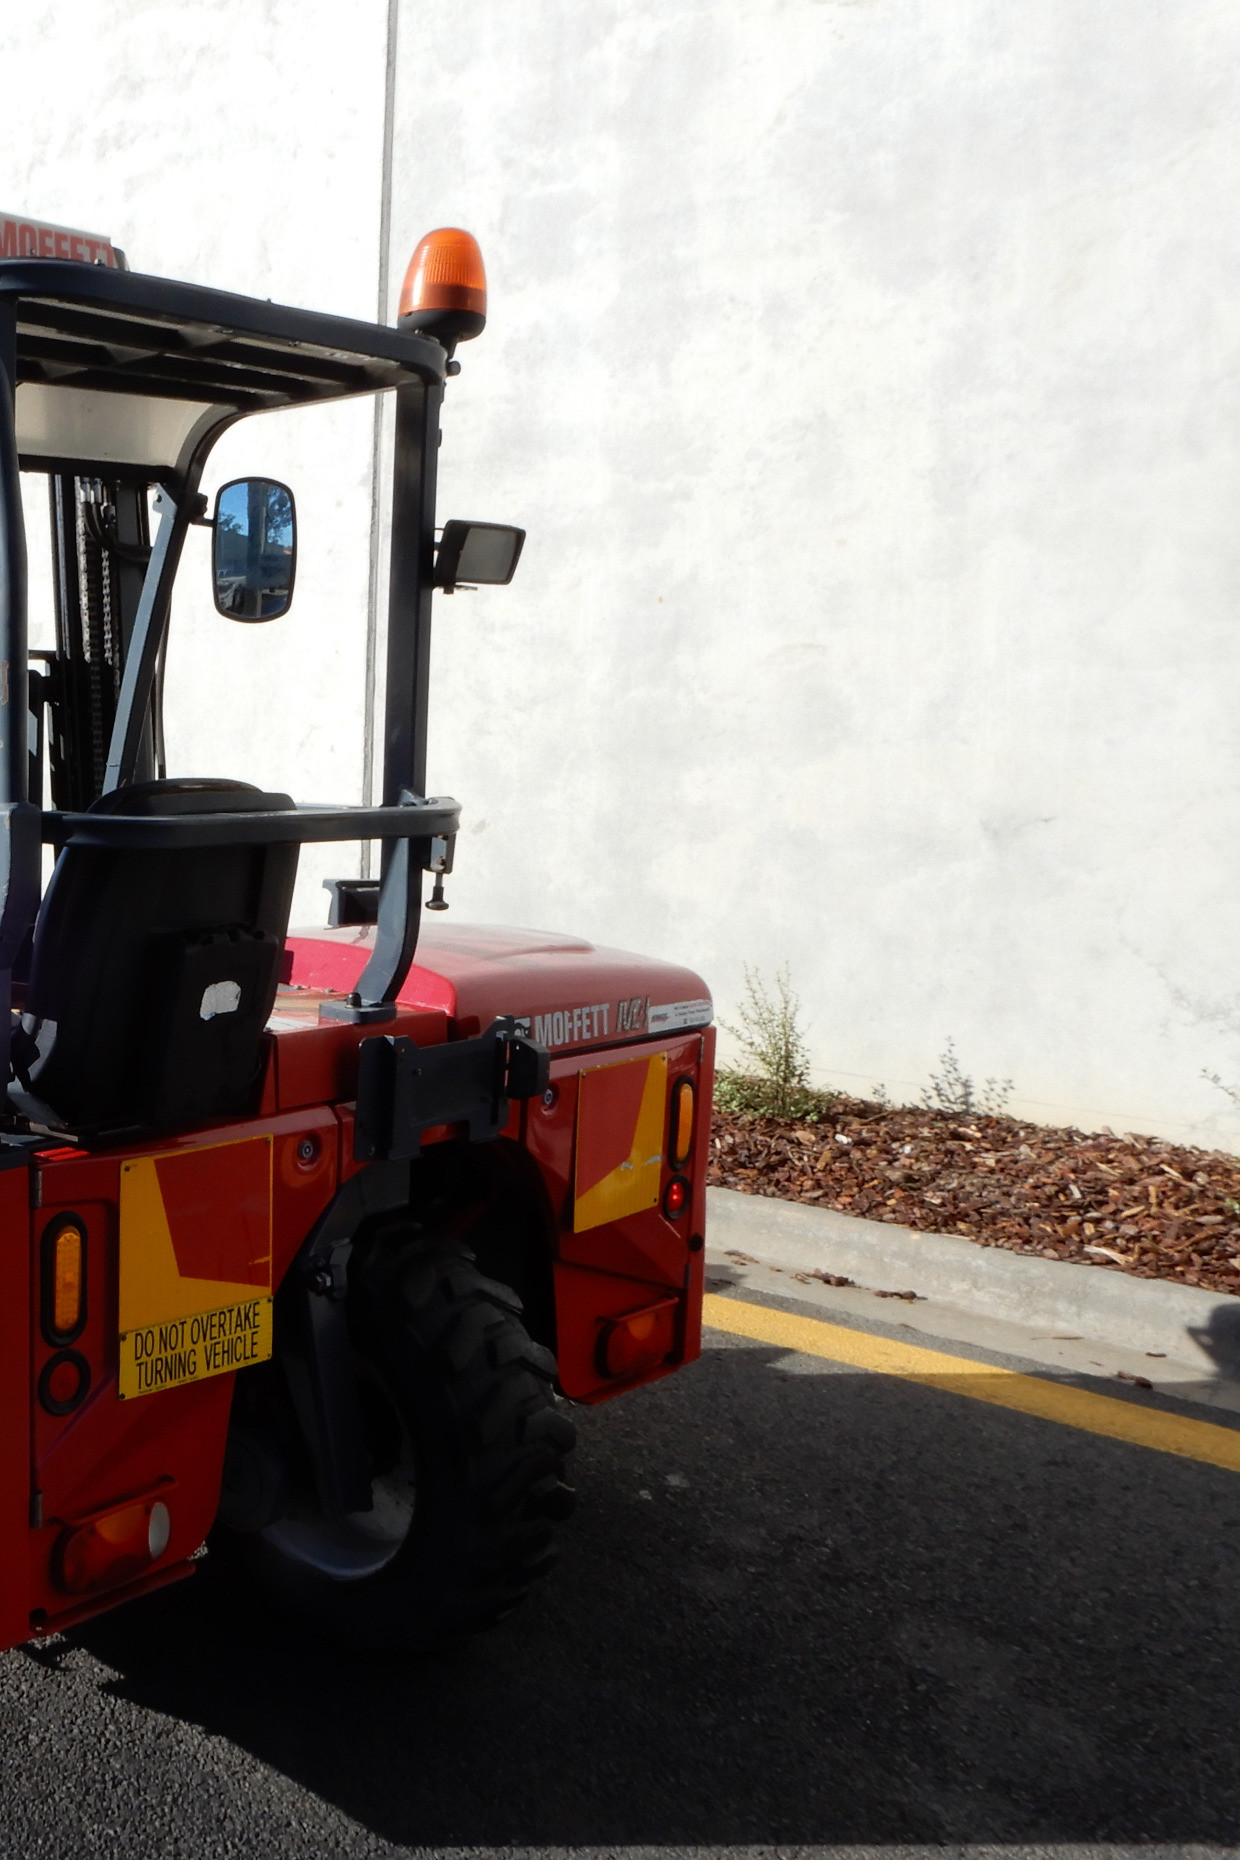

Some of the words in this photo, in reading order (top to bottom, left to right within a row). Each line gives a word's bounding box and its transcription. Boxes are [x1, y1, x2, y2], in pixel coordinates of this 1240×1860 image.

[534, 1003, 610, 1048] MOFFETT
[135, 1329, 155, 1361] DO
[159, 1321, 187, 1355] NOT
[190, 1302, 260, 1345] OVERTAKE
[136, 1349, 197, 1390] TURNING
[204, 1331, 259, 1371] VEHICLE
